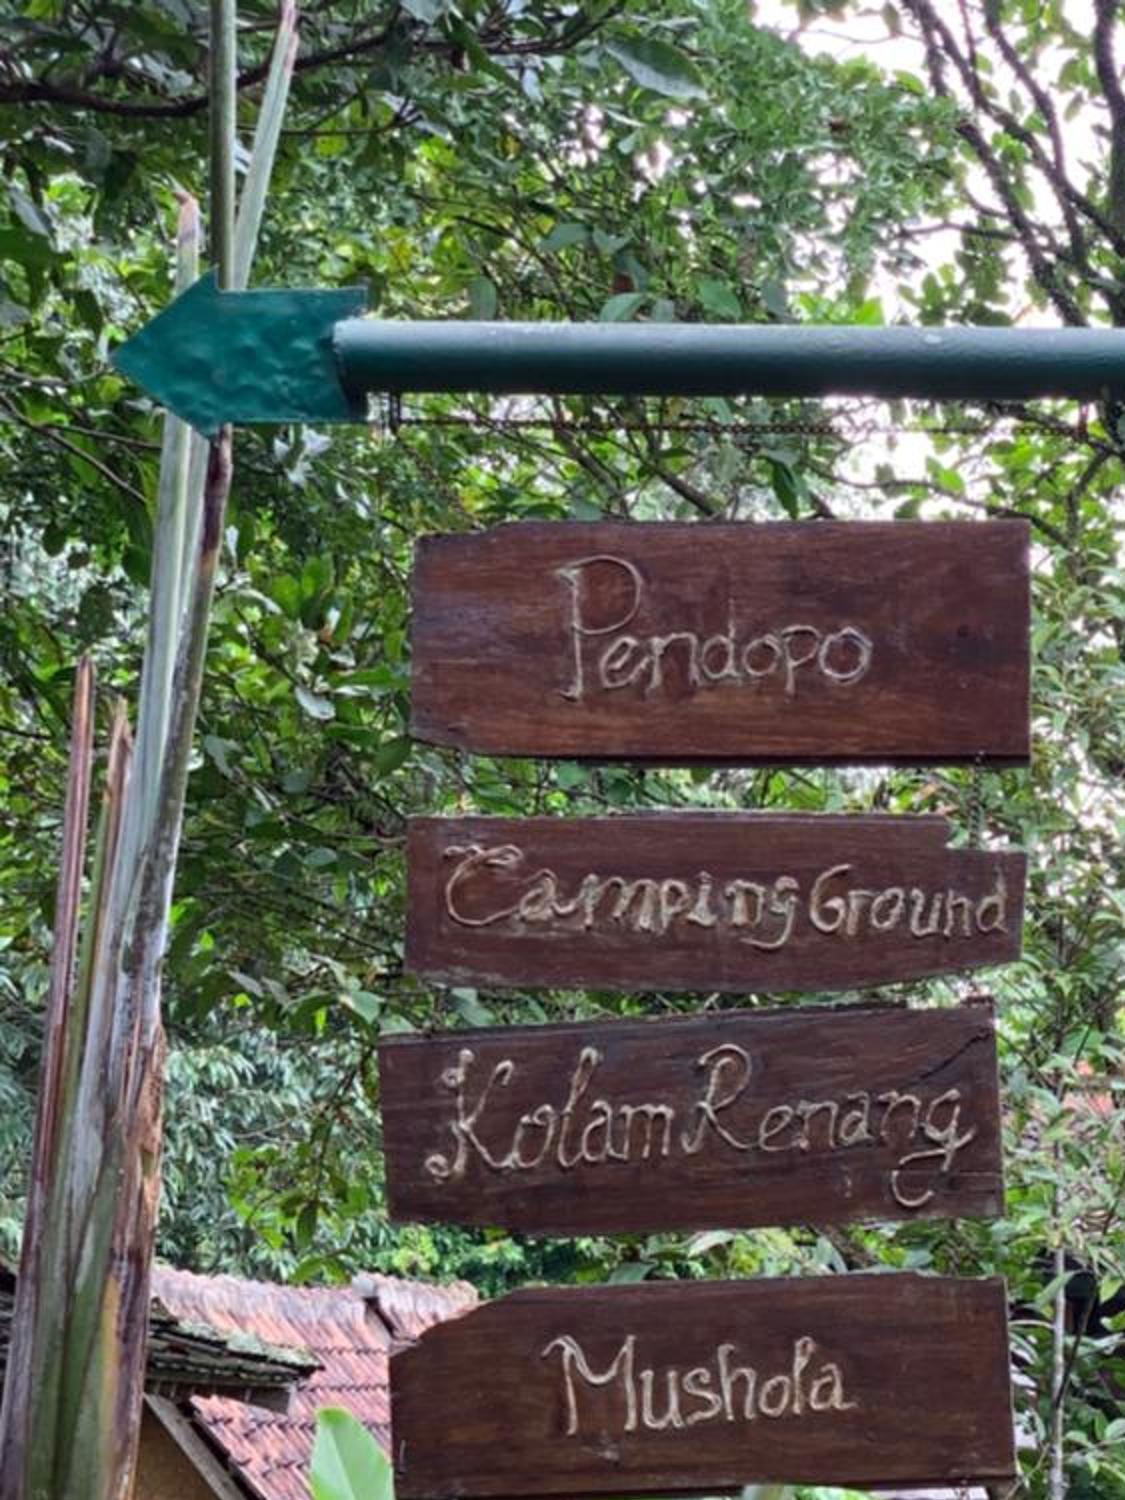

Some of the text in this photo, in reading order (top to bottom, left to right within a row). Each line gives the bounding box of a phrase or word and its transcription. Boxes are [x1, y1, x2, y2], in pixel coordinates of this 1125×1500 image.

[556, 555, 874, 702] Pendopo
[442, 843, 1009, 950] Camping Ground
[424, 1043, 978, 1207] Kolam Renang
[540, 1334, 856, 1435] Mushola
